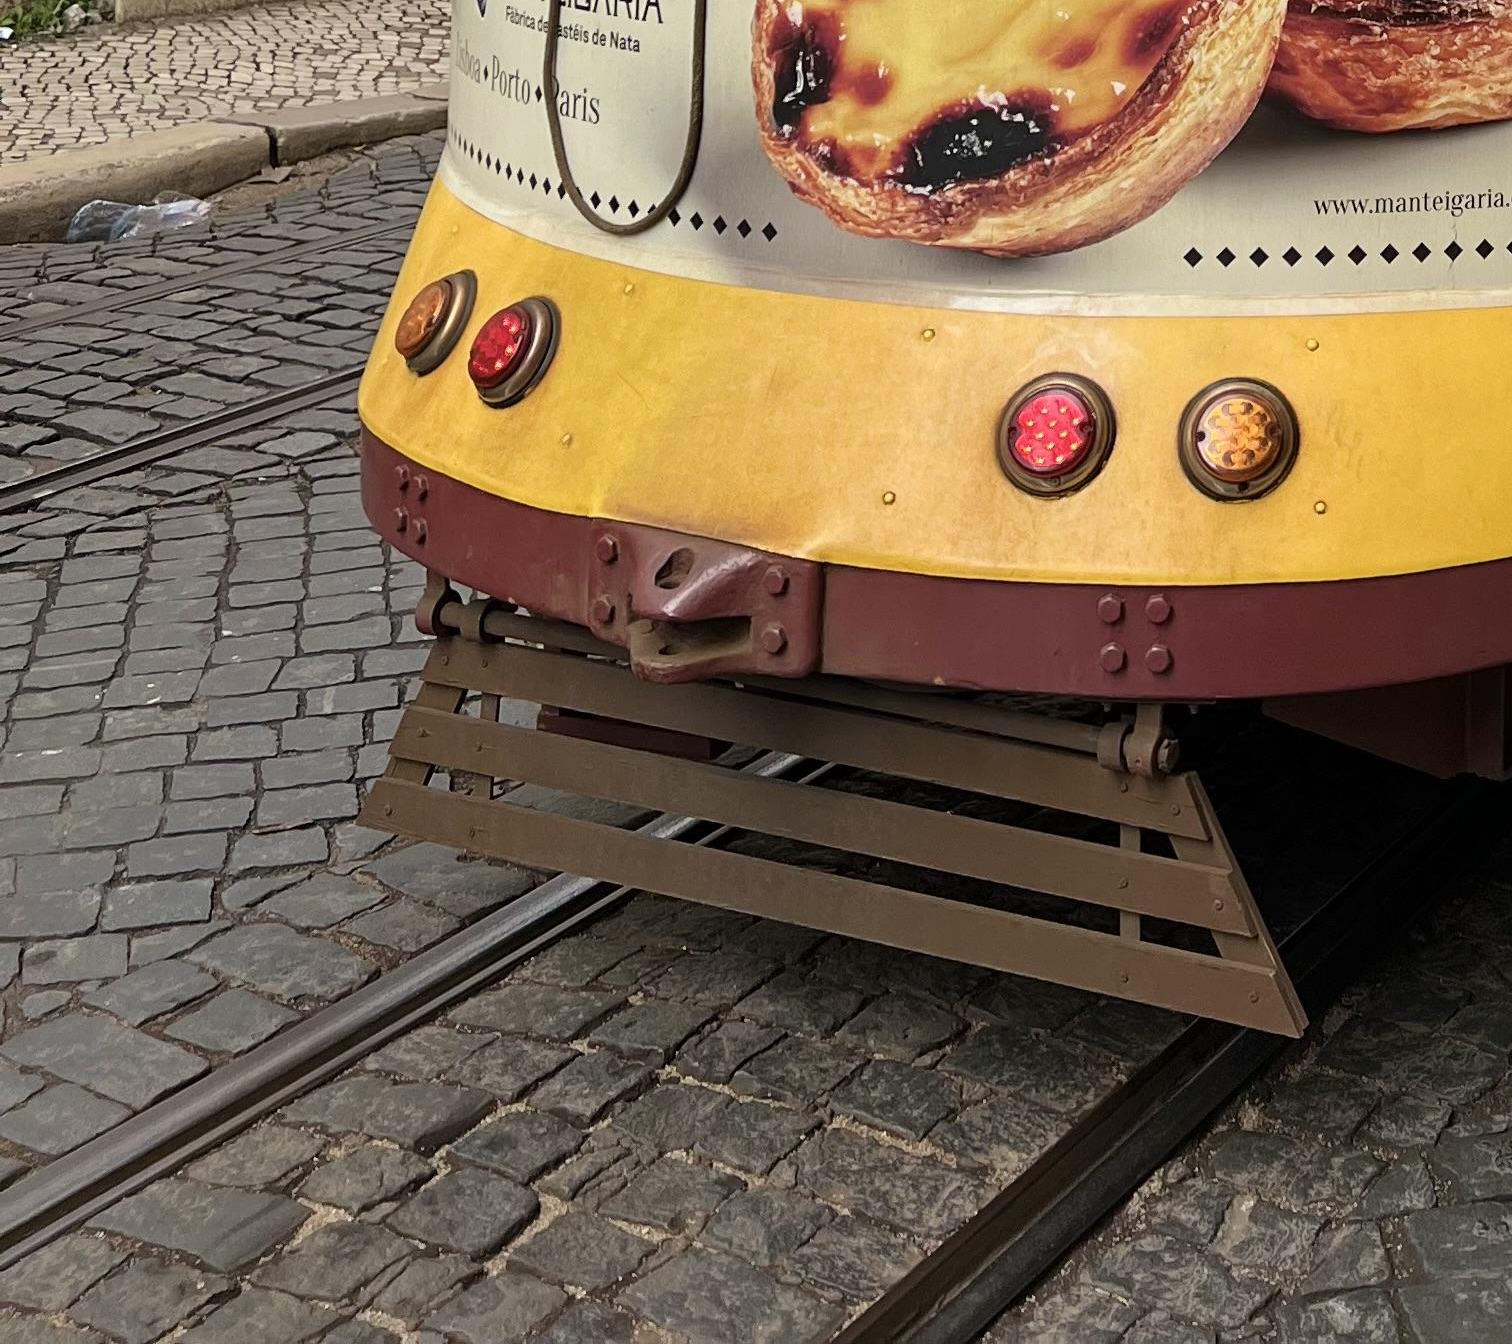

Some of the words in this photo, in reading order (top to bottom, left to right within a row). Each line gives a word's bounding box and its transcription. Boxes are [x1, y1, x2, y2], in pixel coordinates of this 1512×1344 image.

[505, 5, 536, 31] Fábrica
[537, 14, 550, 34] de
[555, 23, 589, 44] astéis
[592, 27, 607, 47] de
[609, 31, 641, 53] Nata
[491, 54, 531, 106] Porto
